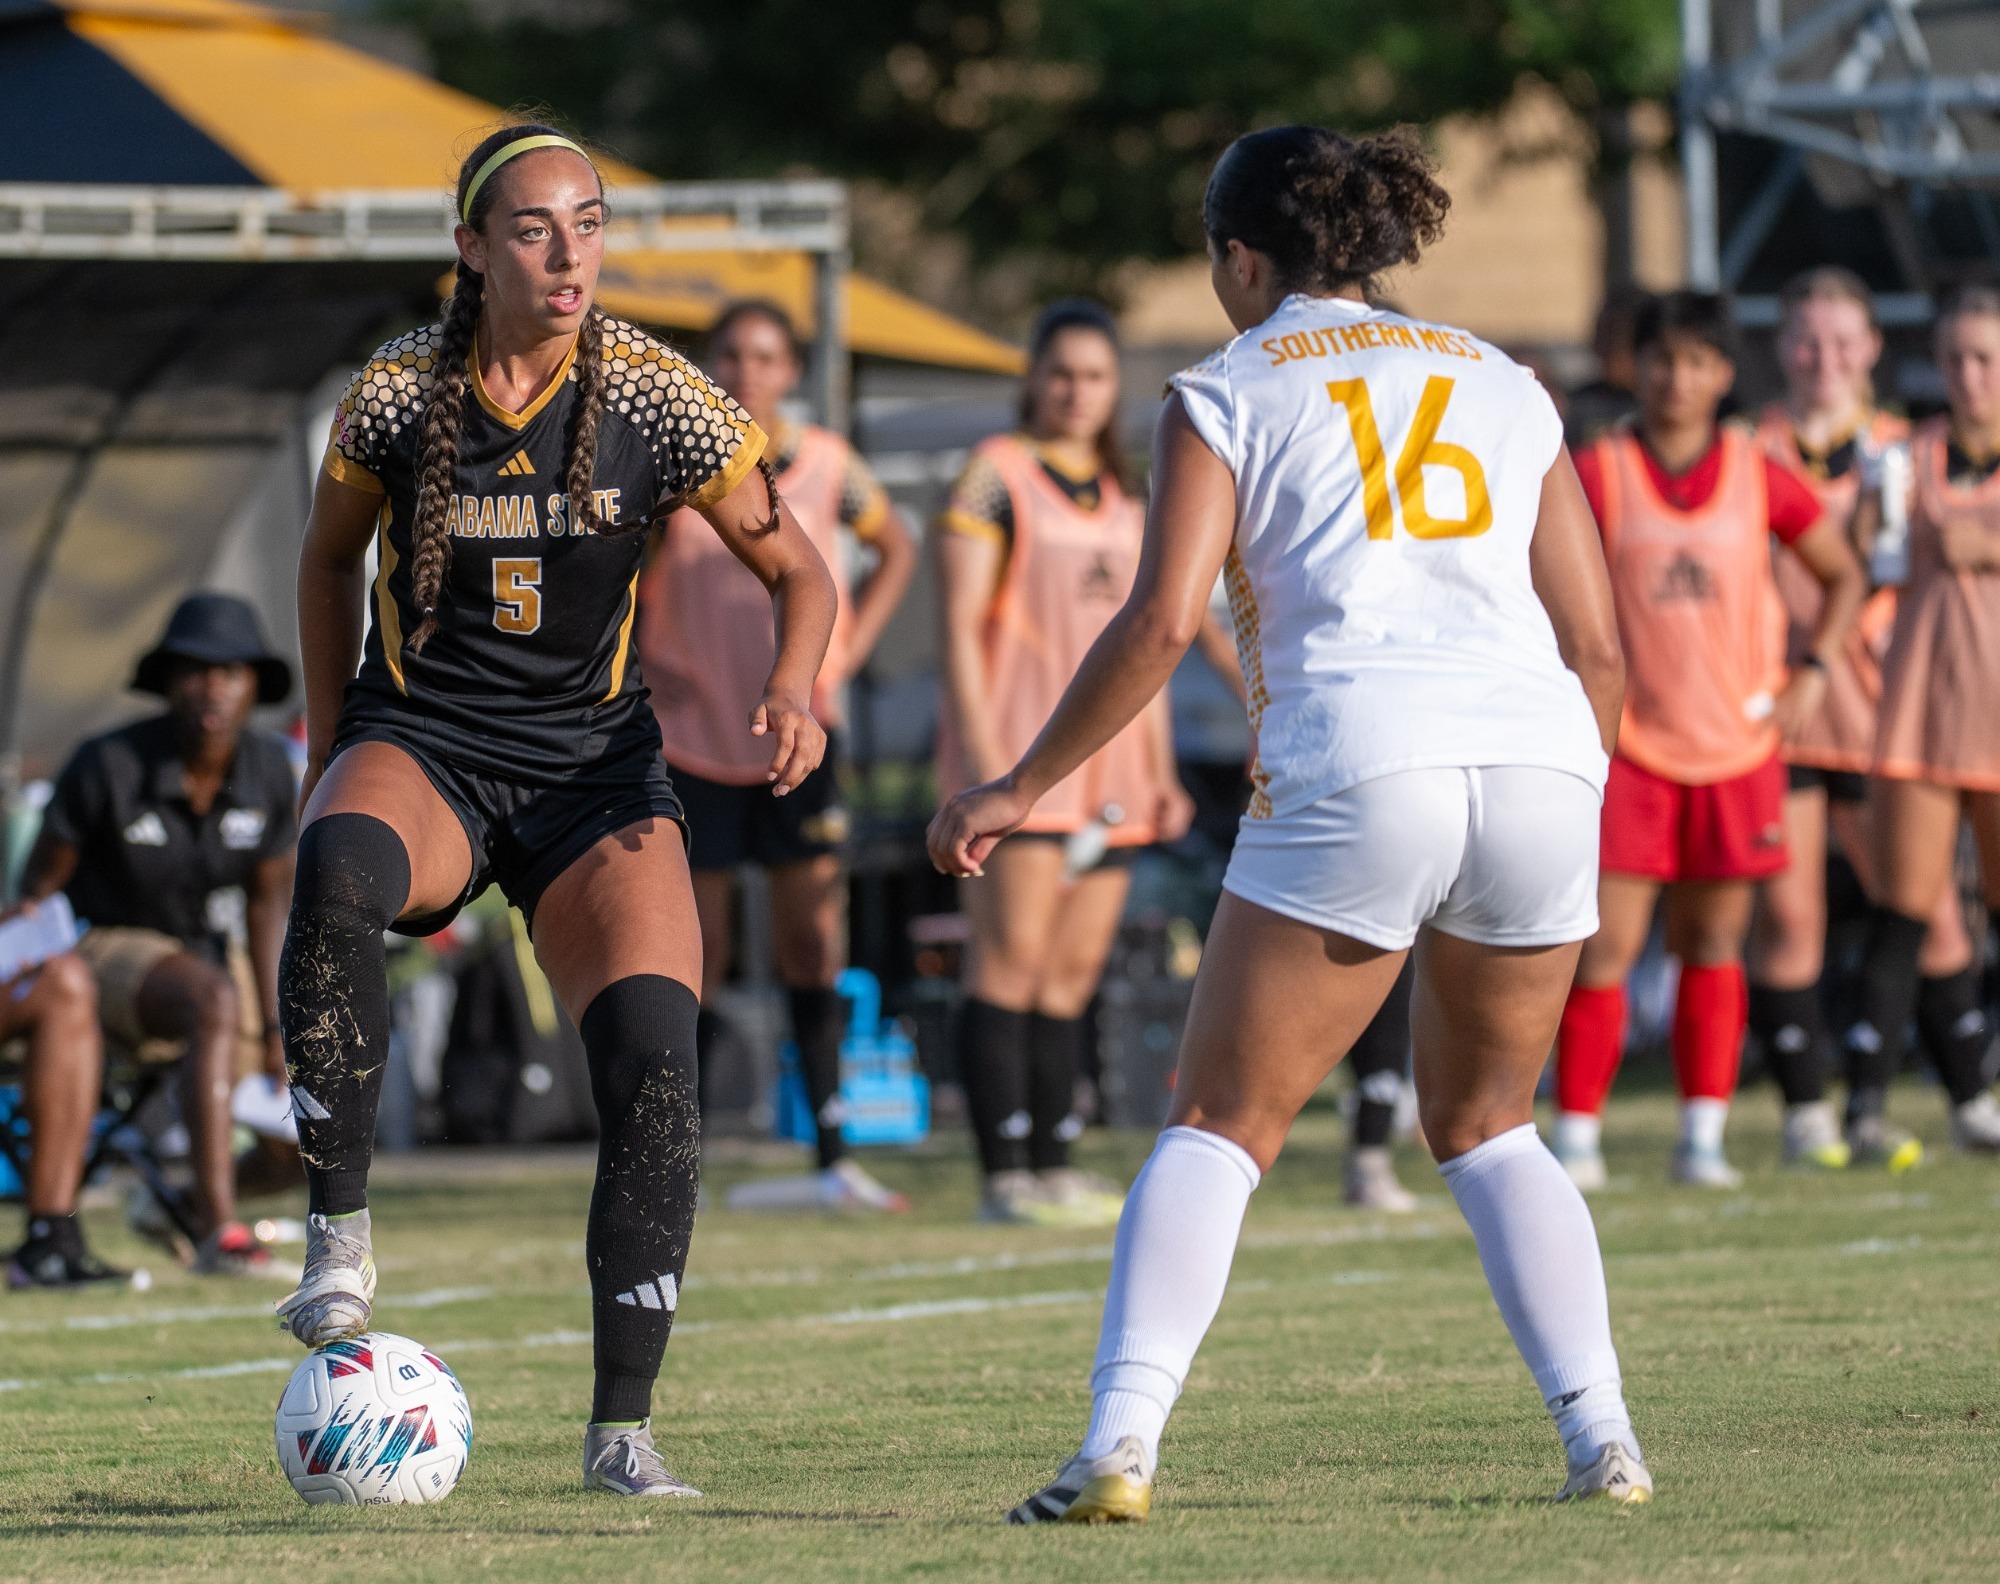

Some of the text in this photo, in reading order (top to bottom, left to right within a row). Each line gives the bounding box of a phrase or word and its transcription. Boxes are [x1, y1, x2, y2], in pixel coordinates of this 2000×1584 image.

[1261, 322, 1482, 367] SOUTHERN MISS
[1325, 374, 1494, 541] 16
[445, 494, 539, 538] ABAMA
[492, 557, 542, 636] 5
